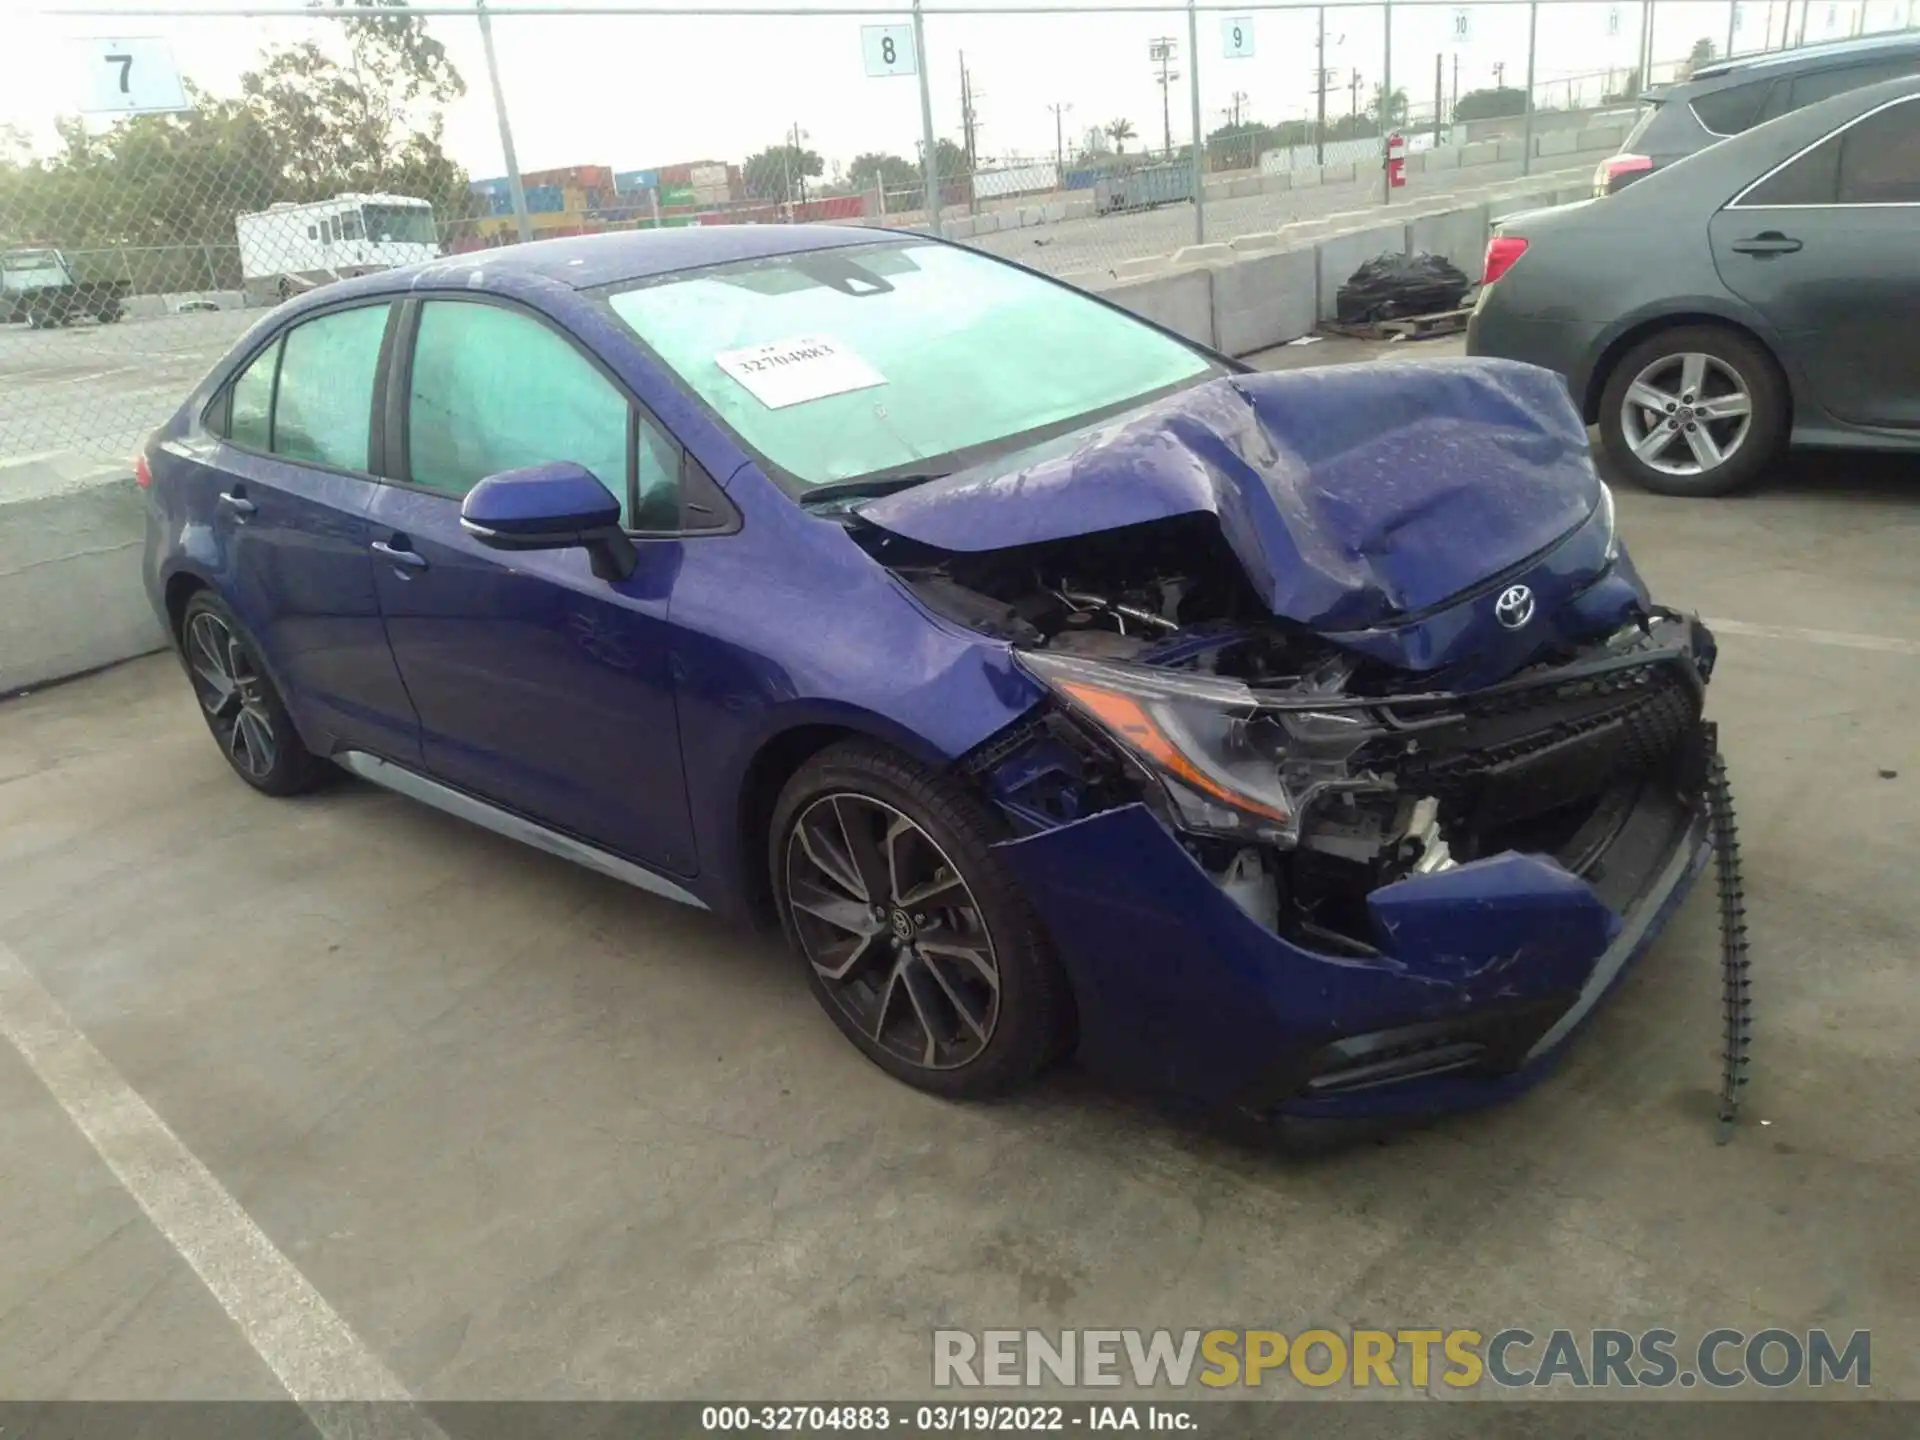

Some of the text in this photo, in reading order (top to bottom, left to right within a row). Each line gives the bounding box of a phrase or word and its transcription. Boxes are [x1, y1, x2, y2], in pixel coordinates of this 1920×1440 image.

[1233, 26, 1242, 48] 9
[1456, 16, 1467, 33] 10
[882, 36, 896, 64] 8
[104, 55, 132, 93] 7
[740, 344, 834, 373] 32704883
